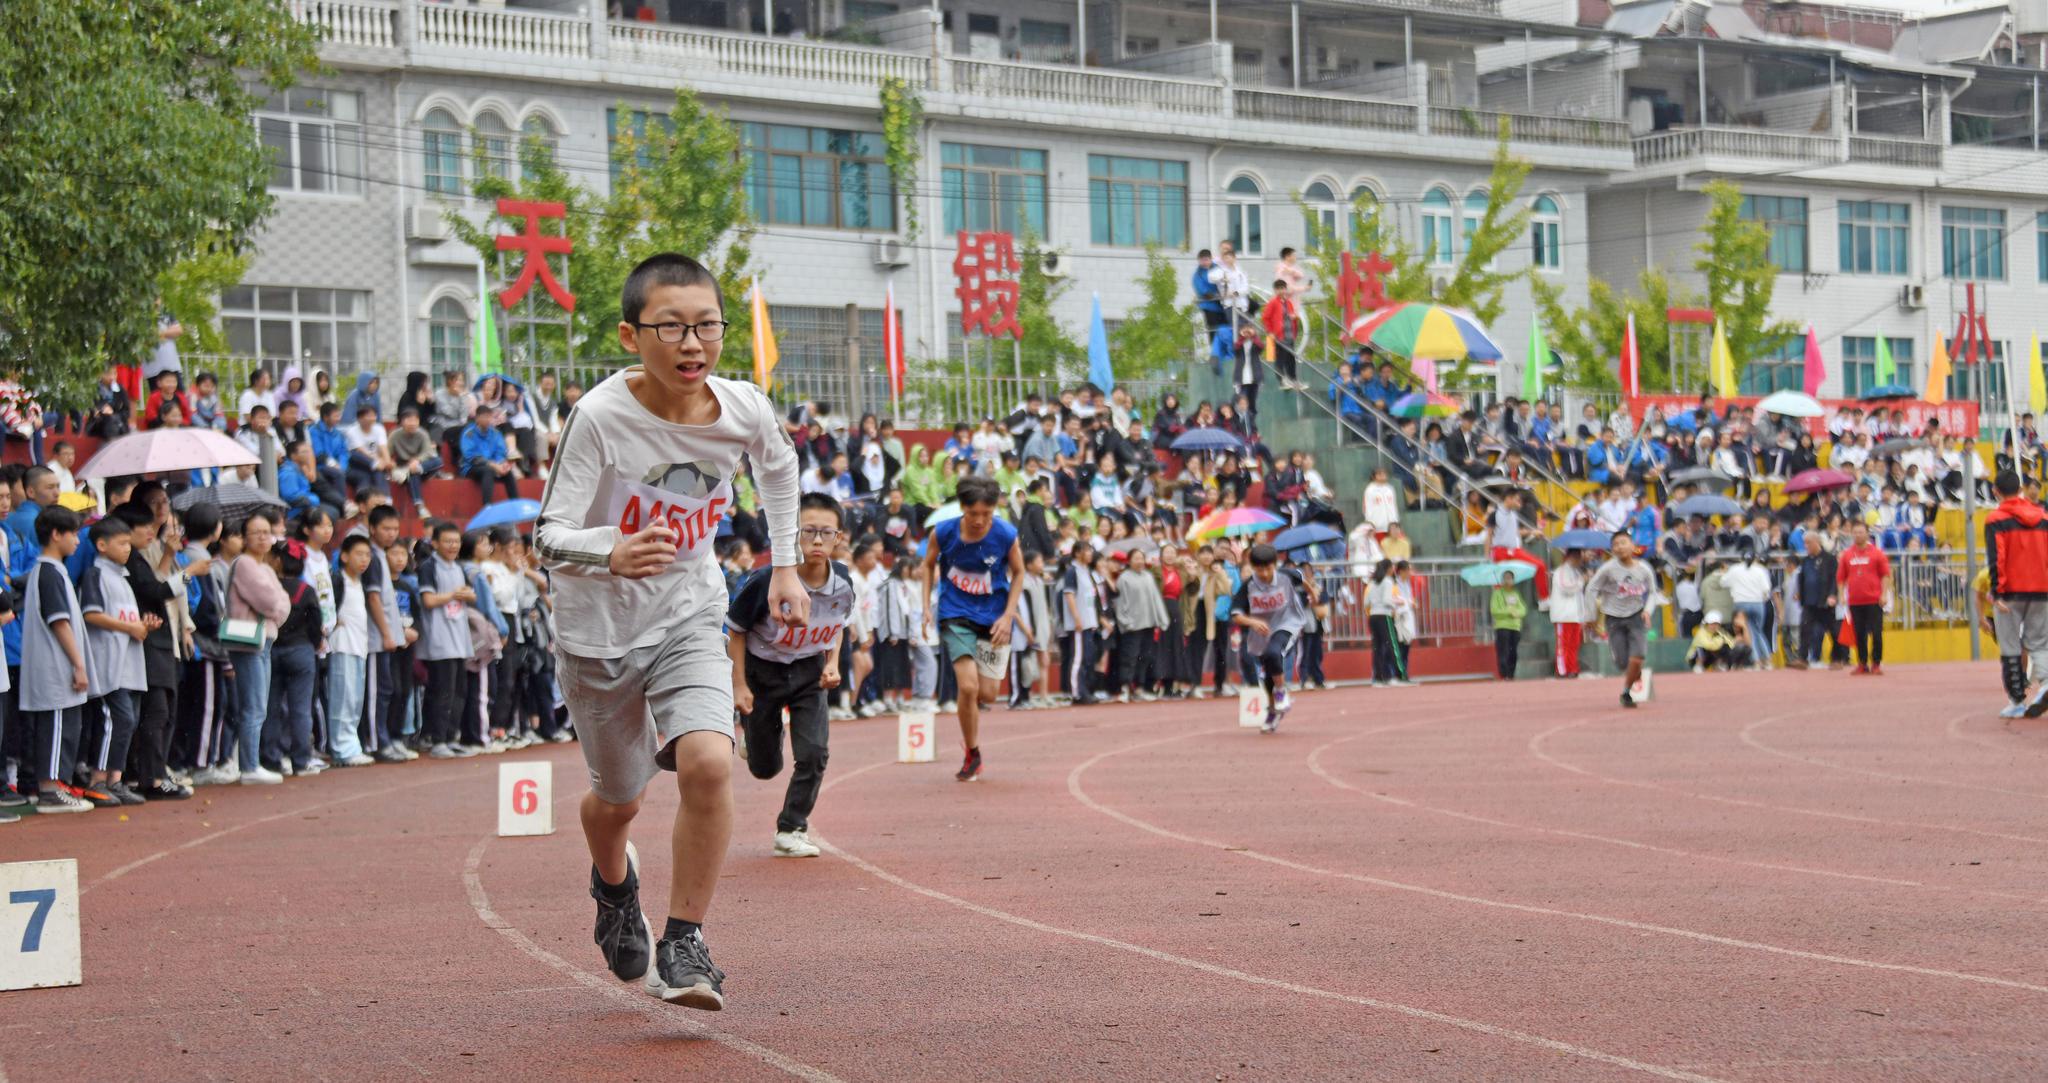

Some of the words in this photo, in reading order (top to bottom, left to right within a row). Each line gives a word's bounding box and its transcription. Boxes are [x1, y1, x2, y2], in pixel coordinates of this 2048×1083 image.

[496, 198, 576, 312] 天
[954, 230, 1024, 340] 锻
[1949, 283, 1994, 364] 小
[1247, 697, 1262, 716] 4
[908, 724, 925, 749] 5
[512, 779, 538, 816] 6
[9, 889, 56, 953] 7
